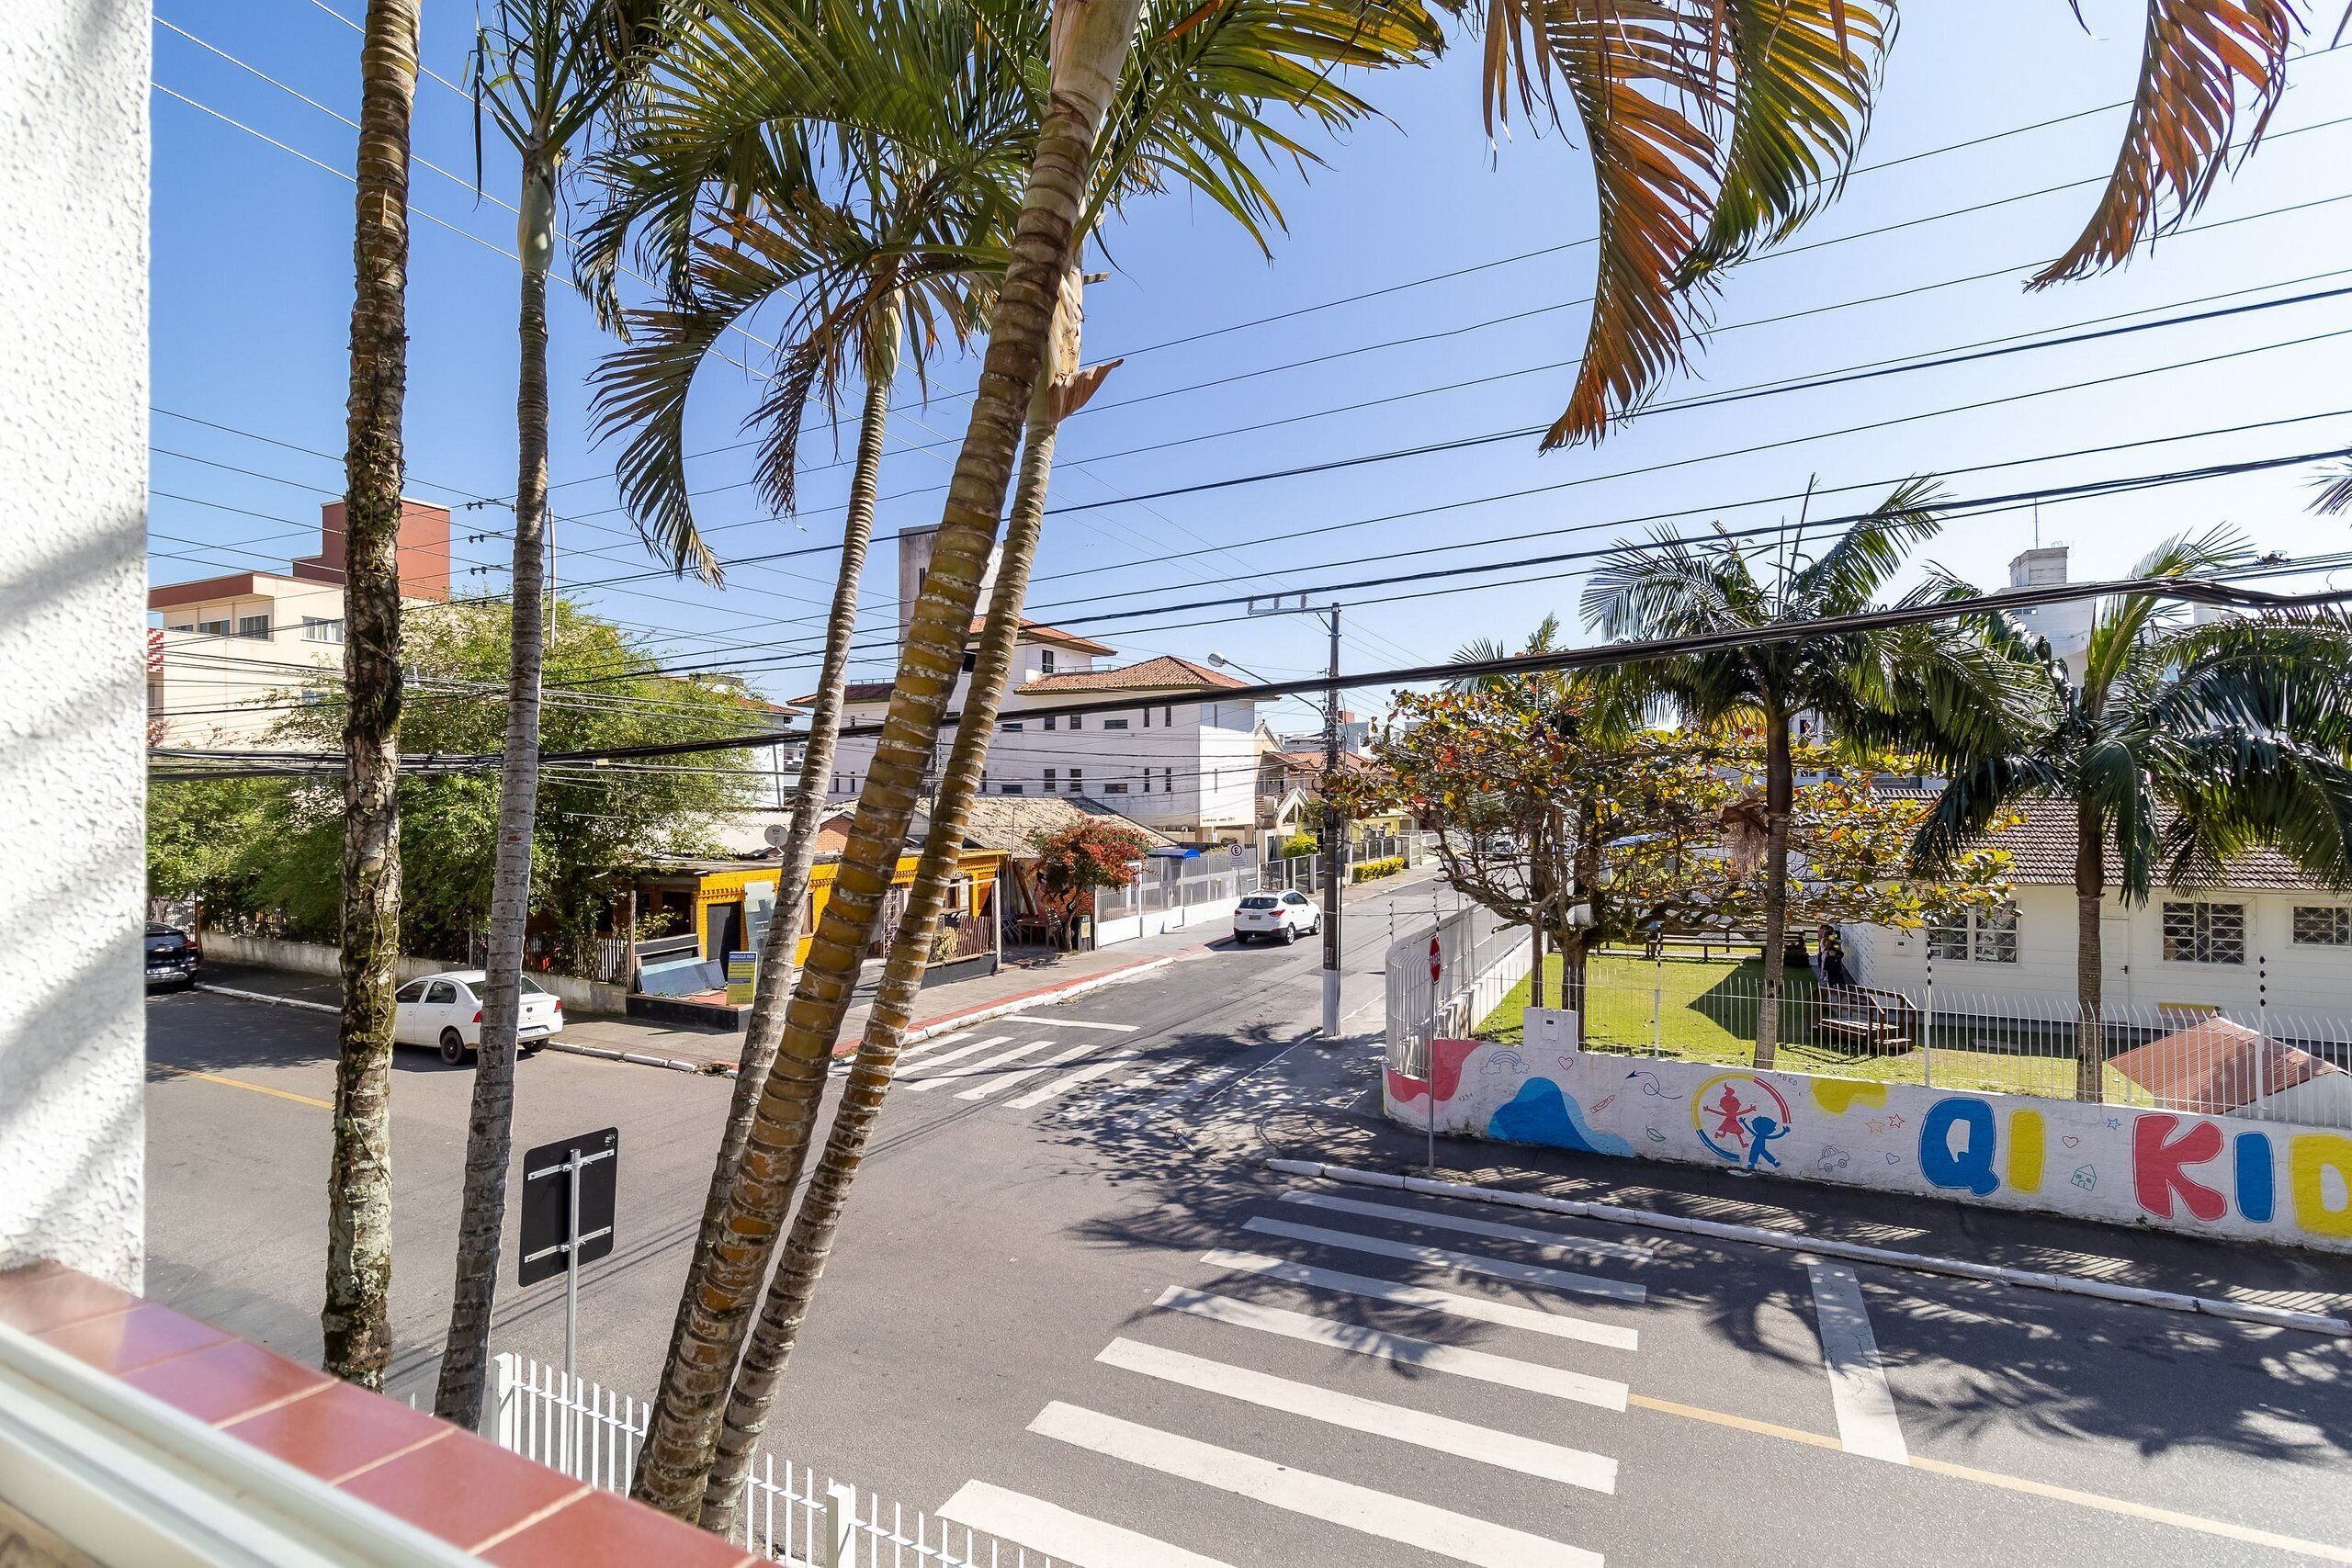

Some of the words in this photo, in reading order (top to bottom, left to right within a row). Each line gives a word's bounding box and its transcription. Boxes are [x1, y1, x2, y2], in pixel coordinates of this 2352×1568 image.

[1777, 1072, 1798, 1086] ABCD
[1918, 1097, 2046, 1196] QI
[2132, 1113, 2352, 1238] KID
